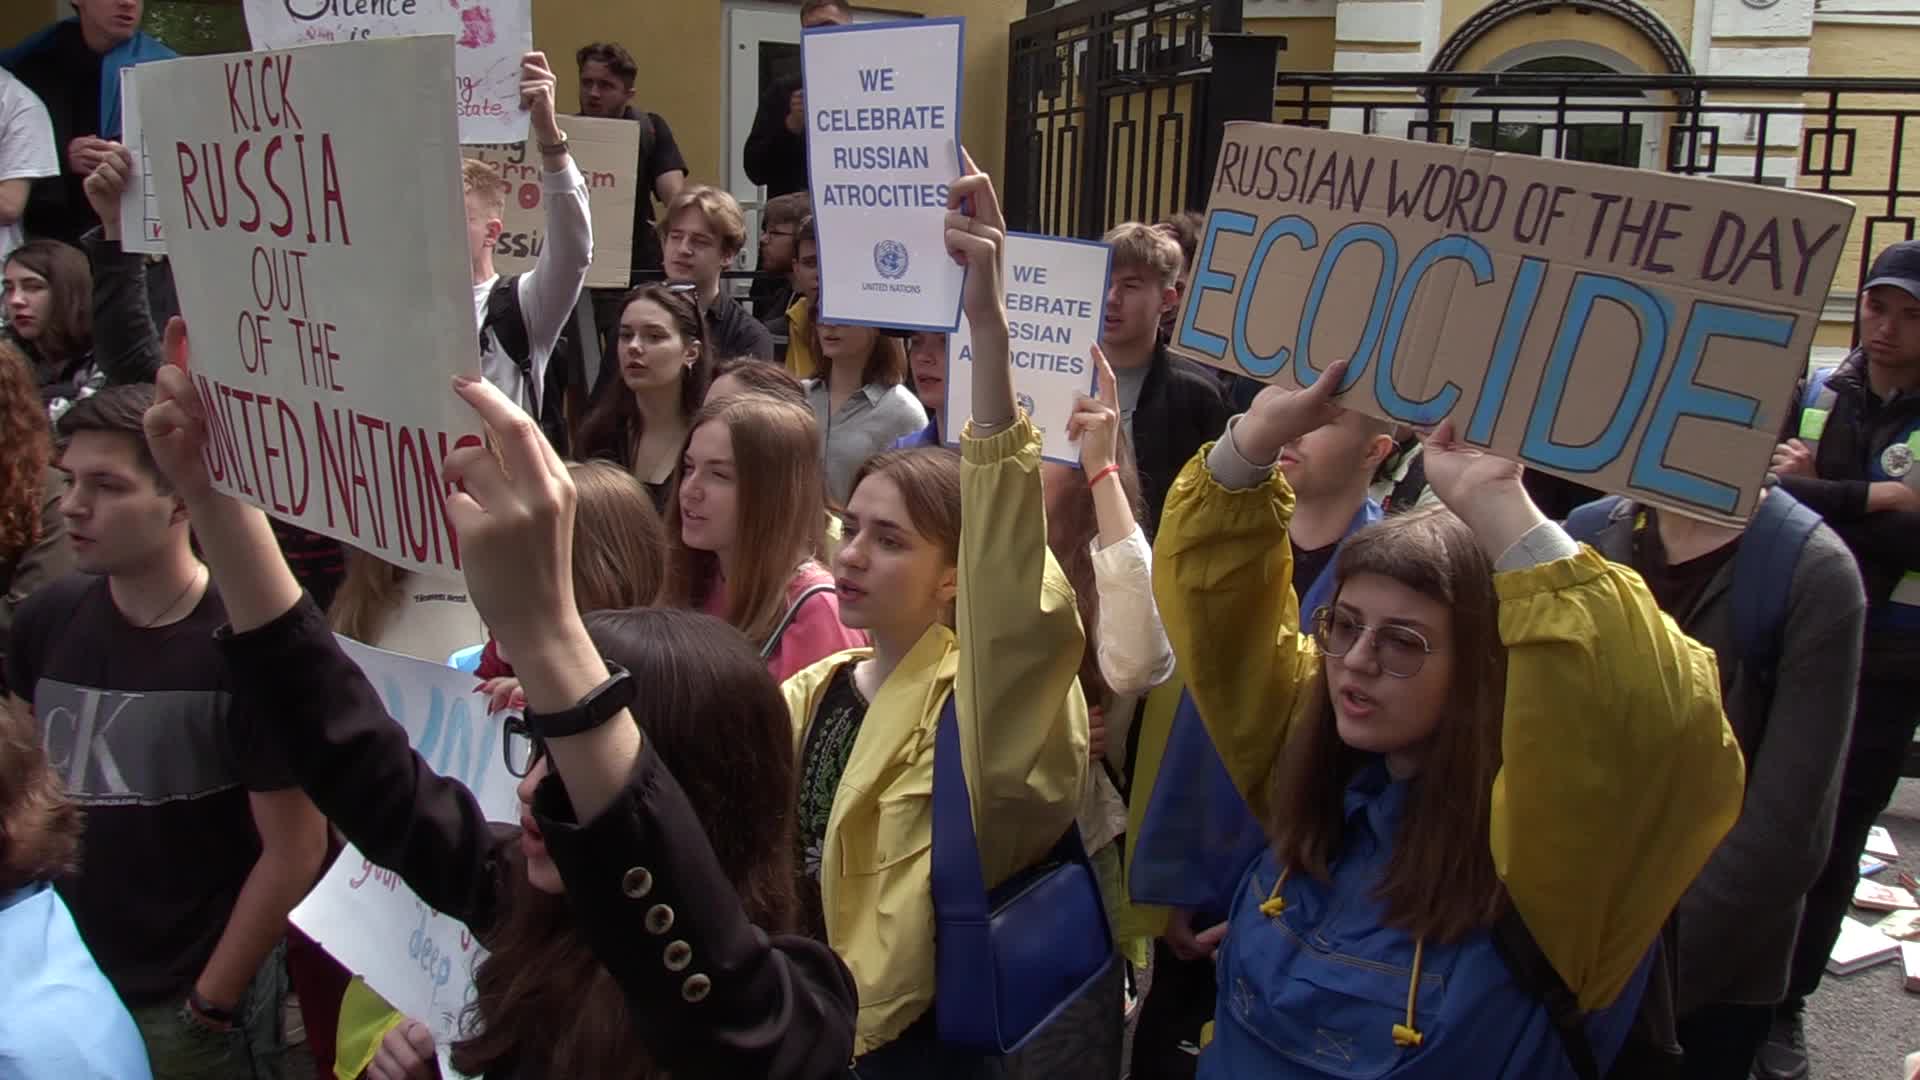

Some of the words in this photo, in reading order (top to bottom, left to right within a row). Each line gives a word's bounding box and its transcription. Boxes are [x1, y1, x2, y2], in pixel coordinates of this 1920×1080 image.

[224, 55, 302, 133] KICK
[859, 68, 894, 92] WE
[817, 106, 945, 132] CELEBRATE
[834, 147, 929, 169] RUSSIAN
[176, 133, 351, 246] RUSSIA
[824, 184, 950, 207] ATROCITIES
[1217, 142, 1375, 213] RUSSIAN
[1387, 159, 1508, 232] WORD
[1513, 182, 1576, 245] OF
[1584, 192, 1692, 273] THE
[1702, 210, 1841, 296] DAY
[252, 246, 308, 318] OUT
[1013, 265, 1048, 284] WE
[1006, 293, 1092, 318] EBRATE
[1008, 321, 1071, 344] SSIAN
[238, 310, 272, 376] OF
[288, 318, 344, 391] THE
[959, 345, 1084, 374] ACITIES
[1178, 208, 1800, 514] ECOCIDE
[190, 371, 309, 516] UNITED
